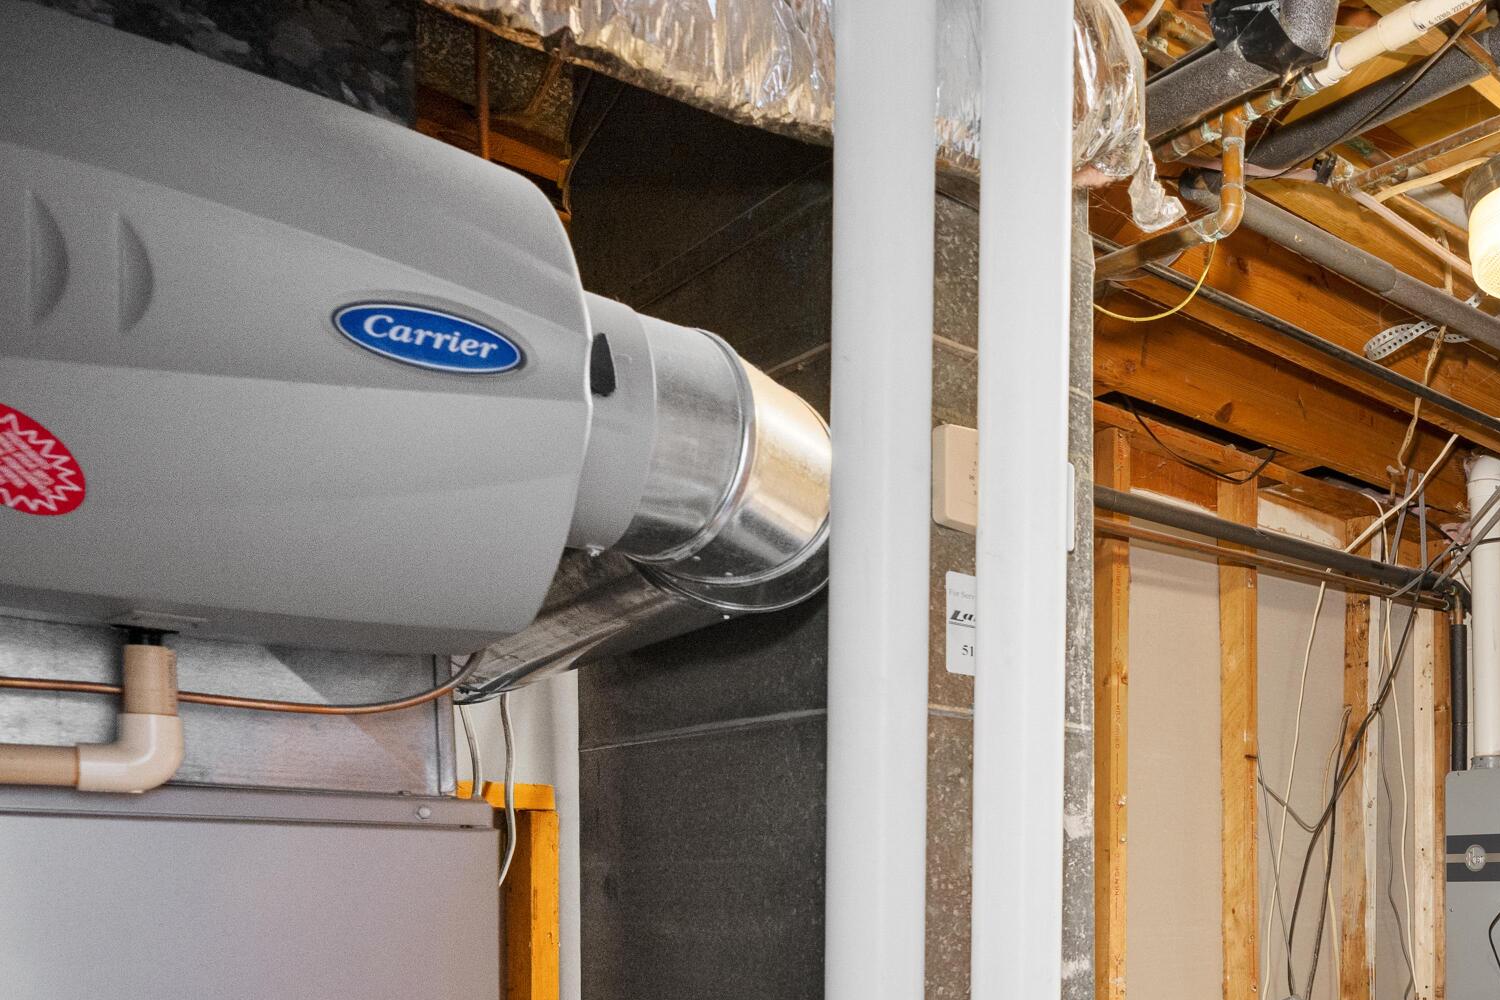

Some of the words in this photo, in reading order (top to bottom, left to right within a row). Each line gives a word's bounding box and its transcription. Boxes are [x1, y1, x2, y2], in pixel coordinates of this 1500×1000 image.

[362, 314, 498, 361] Carrier
[950, 610, 976, 622] La
[961, 645, 974, 657] 51
